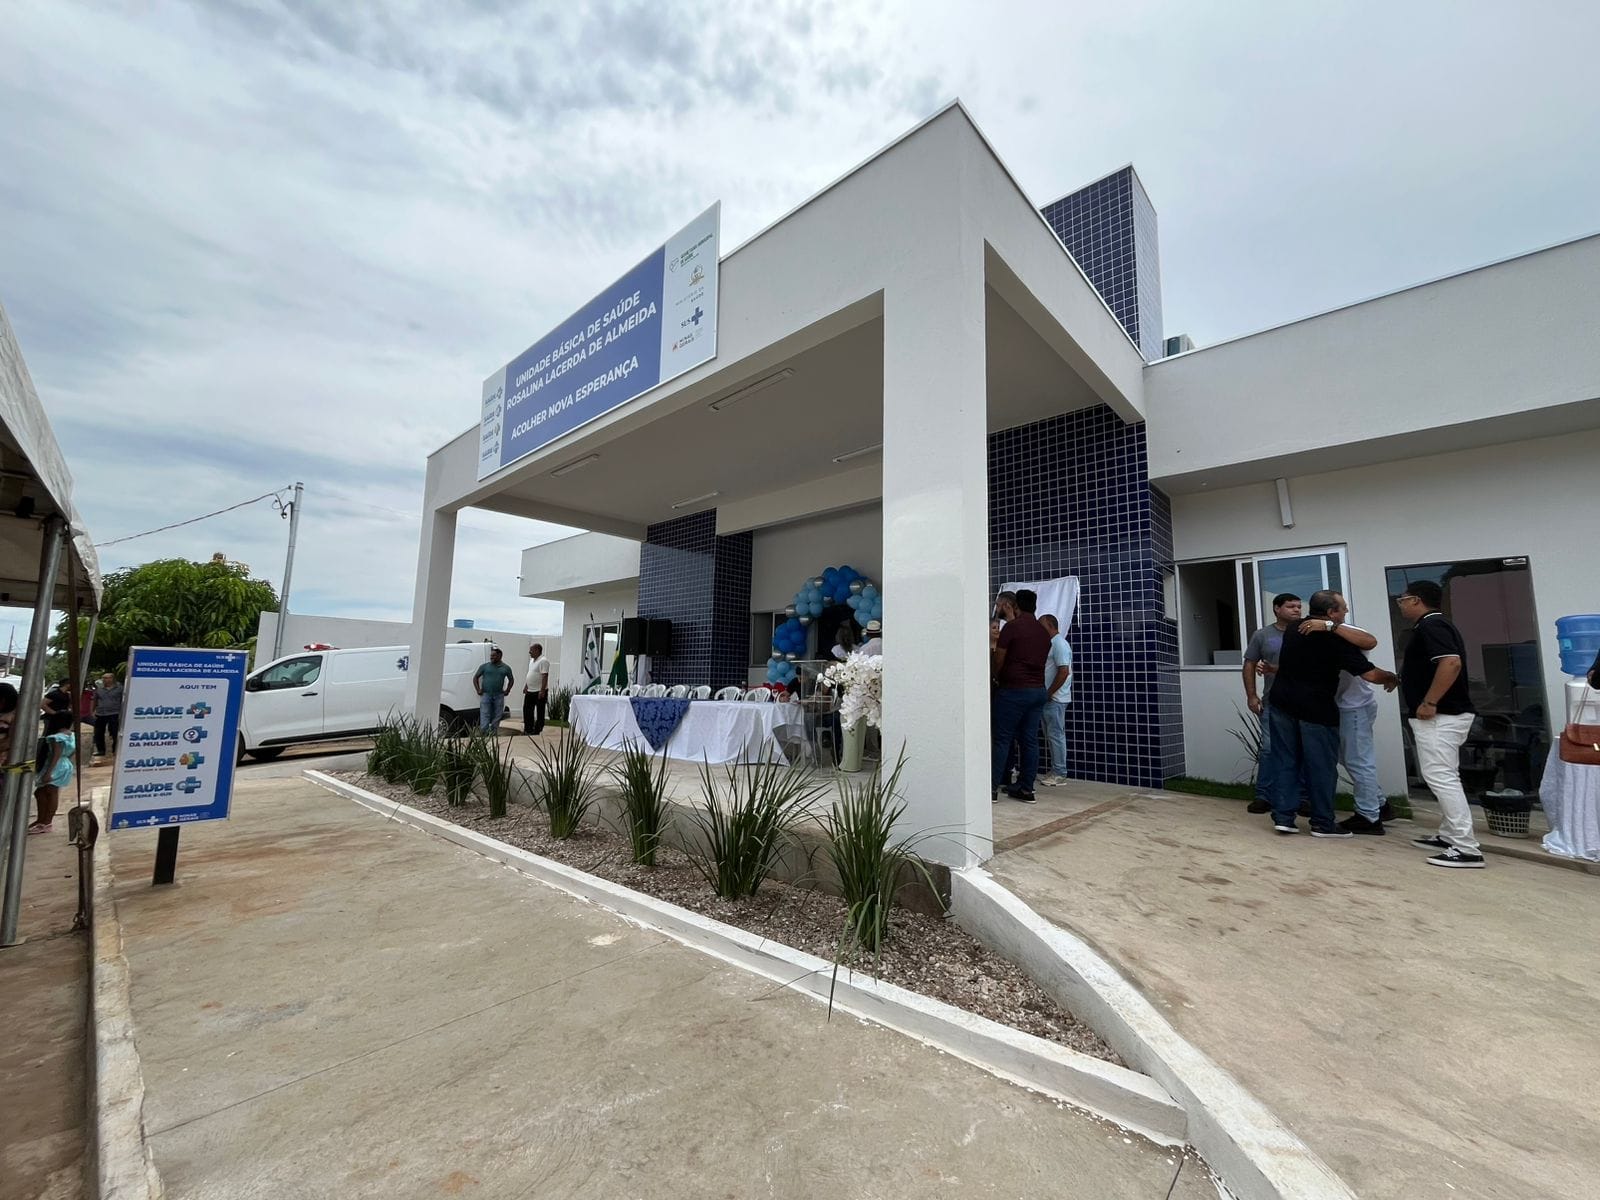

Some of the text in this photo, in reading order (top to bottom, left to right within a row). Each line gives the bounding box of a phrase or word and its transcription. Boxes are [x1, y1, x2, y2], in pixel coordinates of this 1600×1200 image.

[515, 354, 551, 388] UNIDADE
[552, 330, 585, 363] BÁSICA
[587, 318, 602, 338] DE
[603, 290, 641, 328] SAÚDE
[506, 301, 657, 411] ROSALINA LACERDA DE ALMEIDA
[510, 355, 639, 441] ACOLHER NOVA ESPERANÇA
[134, 705, 184, 715] SAÚDE
[129, 730, 180, 741] SAÚDE
[124, 756, 176, 769] SAÚDE
[123, 782, 174, 794] SAÚDE
